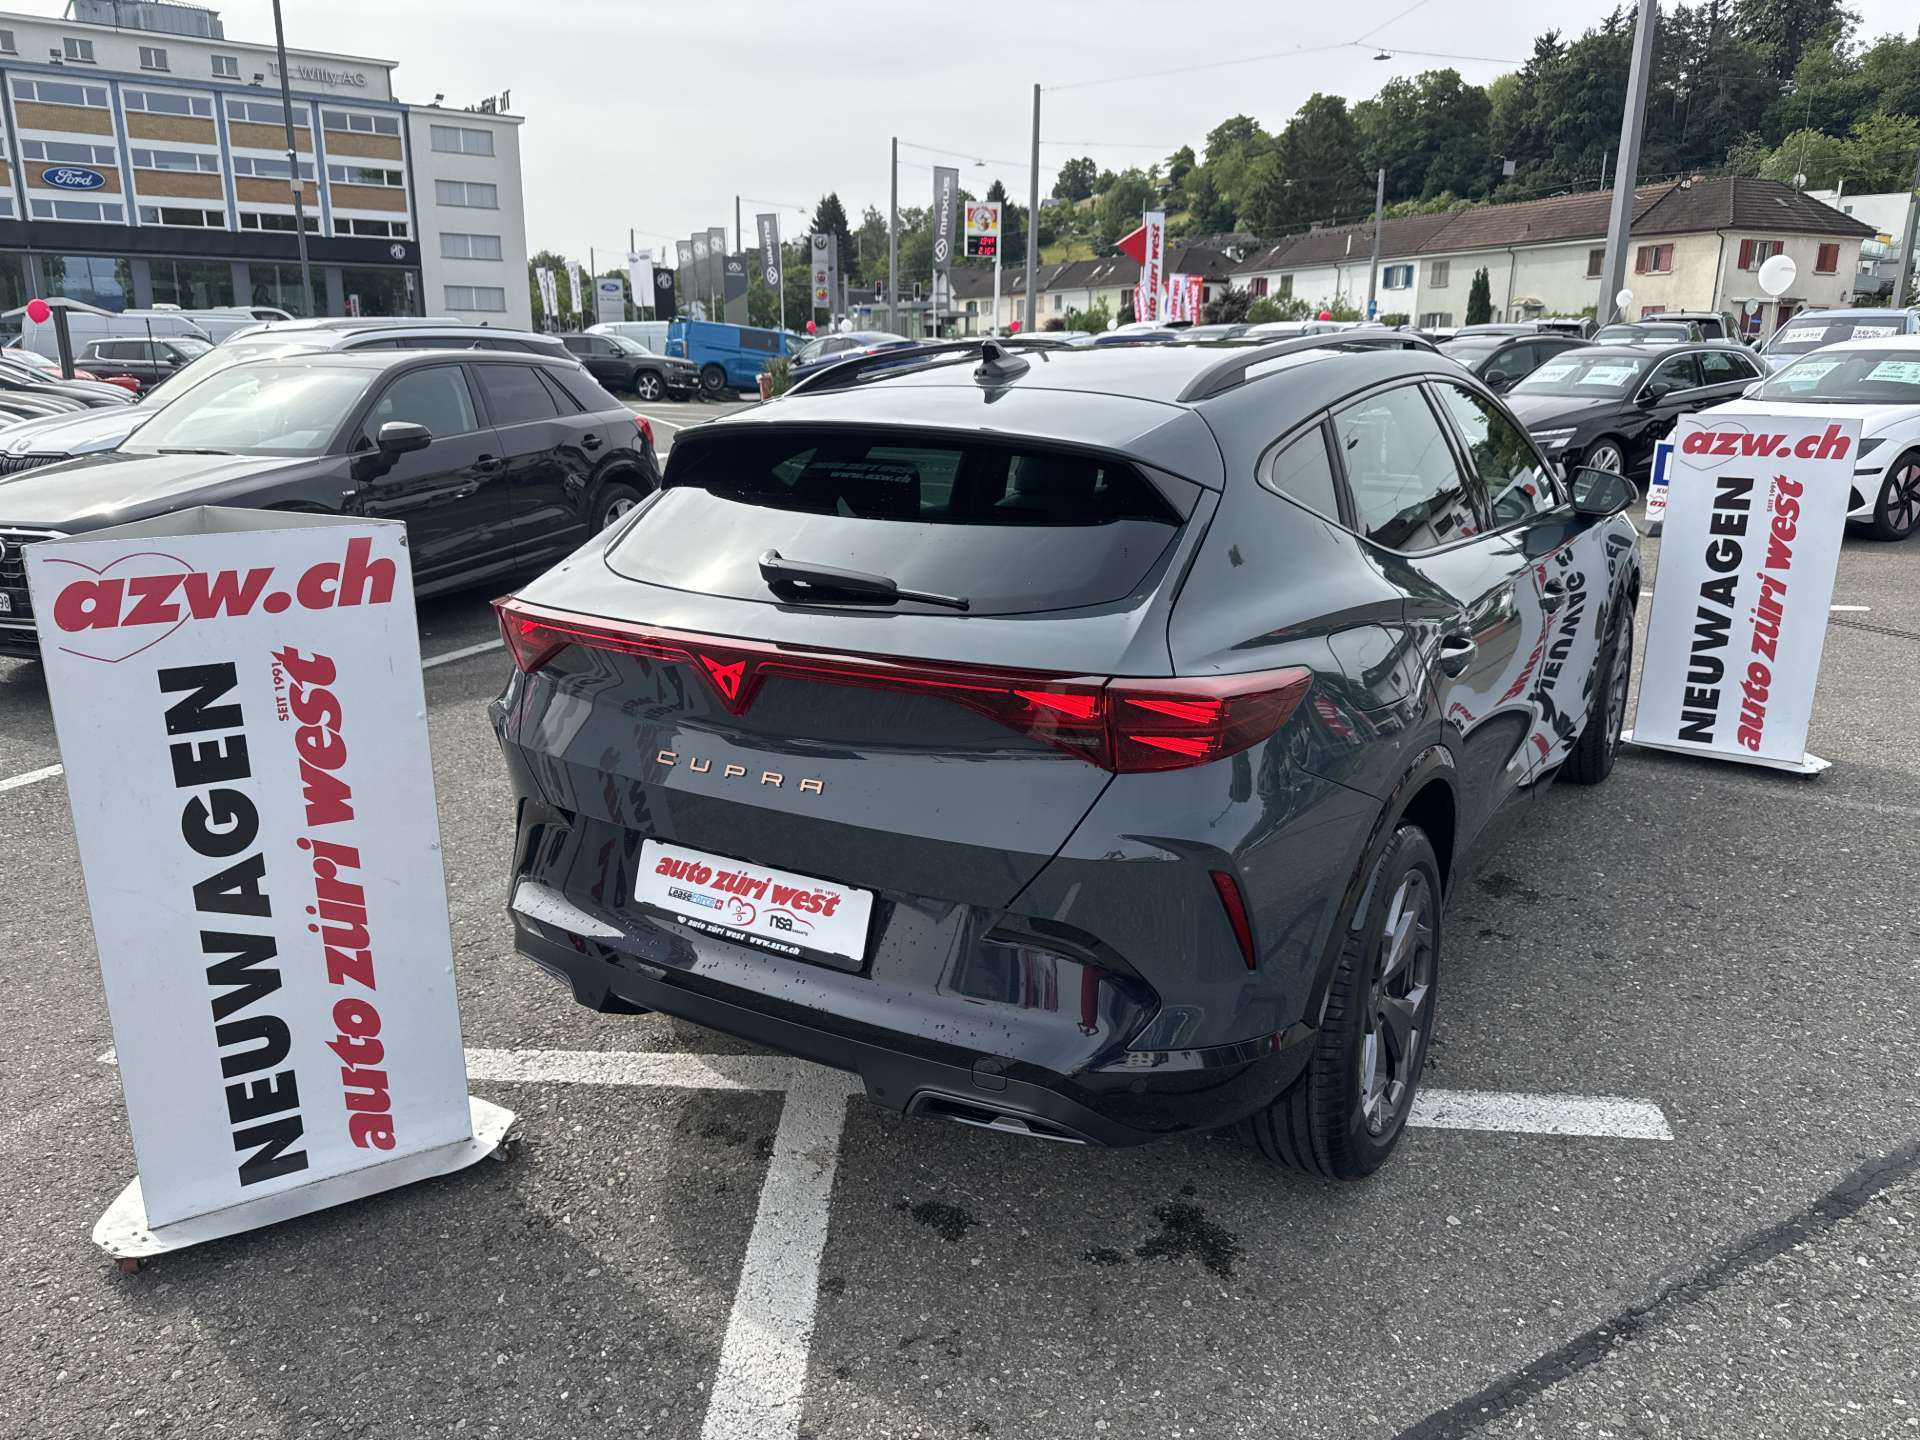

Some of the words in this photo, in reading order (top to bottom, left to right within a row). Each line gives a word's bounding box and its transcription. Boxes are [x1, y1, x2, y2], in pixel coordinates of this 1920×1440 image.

[342, 72, 368, 88] AG
[54, 169, 93, 186] Ford
[939, 176, 951, 236] MAXUS
[656, 272, 672, 289] MG
[1683, 425, 1851, 461] azw.ch
[1766, 498, 1774, 512] SEIT
[1769, 481, 1777, 497] 1991
[1766, 474, 1803, 570] west
[54, 537, 397, 632] azw.ch
[1678, 477, 1754, 745] NEUWAGEN
[1751, 572, 1788, 662] züri
[271, 662, 285, 691] 1991
[276, 696, 290, 722] SEIT
[1737, 664, 1771, 752] auto
[271, 645, 353, 828] west
[655, 749, 826, 796] CUPRA
[655, 856, 713, 885] auto
[710, 870, 773, 900] züri
[771, 884, 842, 917] west
[158, 662, 309, 1187] NEUWAGEN
[302, 838, 376, 991] züri
[687, 919, 706, 929] auto
[706, 923, 725, 936] züri
[725, 930, 746, 941] west
[749, 936, 801, 956] www.azw.ch
[769, 914, 793, 932] nsa
[325, 998, 396, 1150] auto
